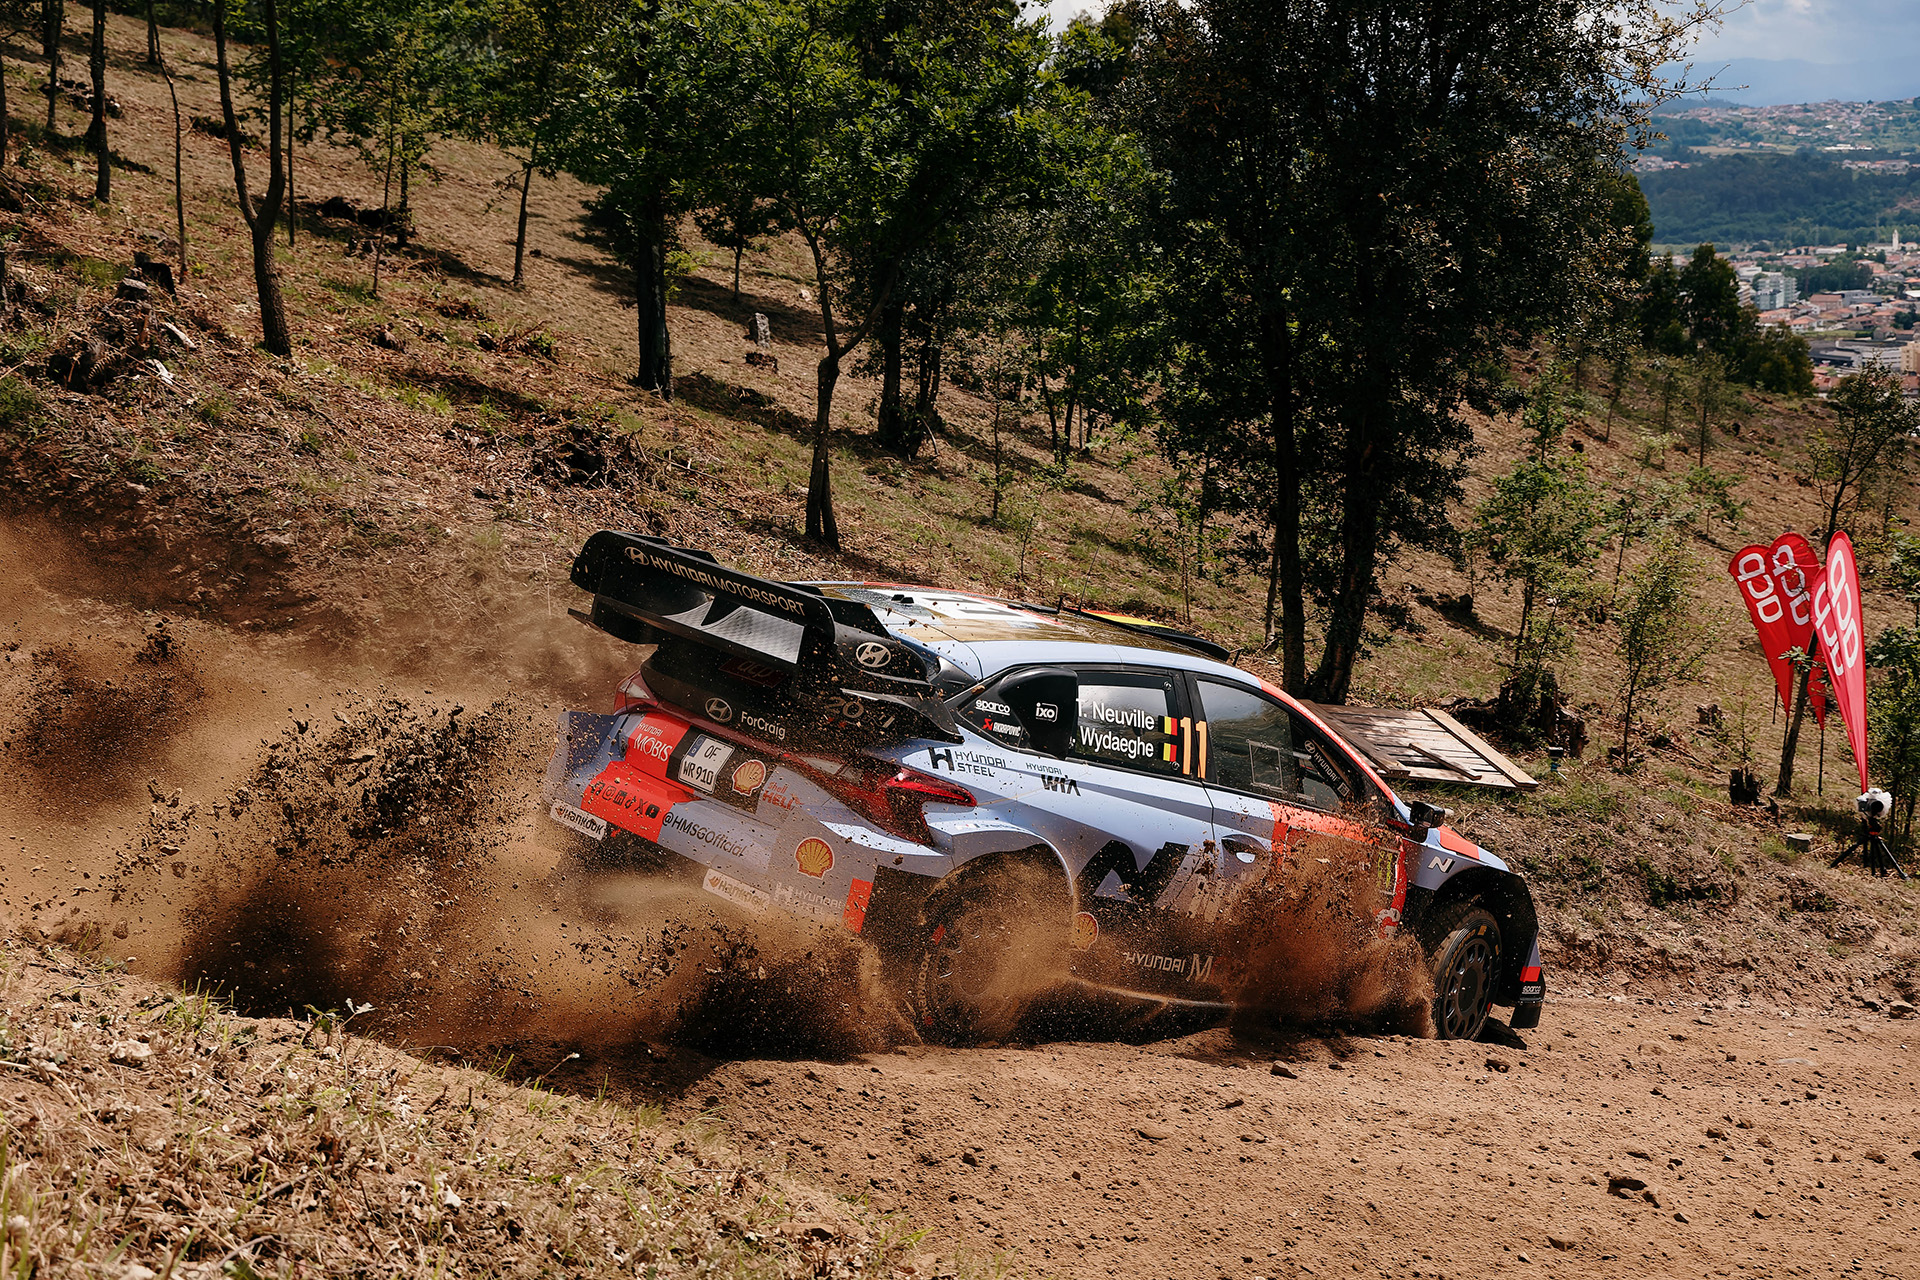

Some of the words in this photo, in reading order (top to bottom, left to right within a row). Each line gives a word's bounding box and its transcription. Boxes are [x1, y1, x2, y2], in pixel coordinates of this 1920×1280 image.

[649, 554, 715, 588] HYUNDAI
[712, 575, 806, 617] MOTORSPORT
[975, 699, 1011, 715] sparco
[1092, 701, 1155, 730] Neuville
[638, 722, 664, 737] HYUNDAI
[741, 710, 786, 741] ForCraig
[632, 733, 674, 762] MOBIS
[703, 744, 722, 759] OF
[1080, 725, 1155, 759] Wydaeghe
[1180, 716, 1208, 780] 11
[954, 750, 1007, 769] HYUNDAI
[956, 762, 996, 778] STEEL
[1025, 762, 1063, 775] HYUNDAI
[1313, 752, 1338, 783] HYUNDAI
[695, 764, 715, 786] 910
[662, 811, 748, 858] @HMSGOfficial
